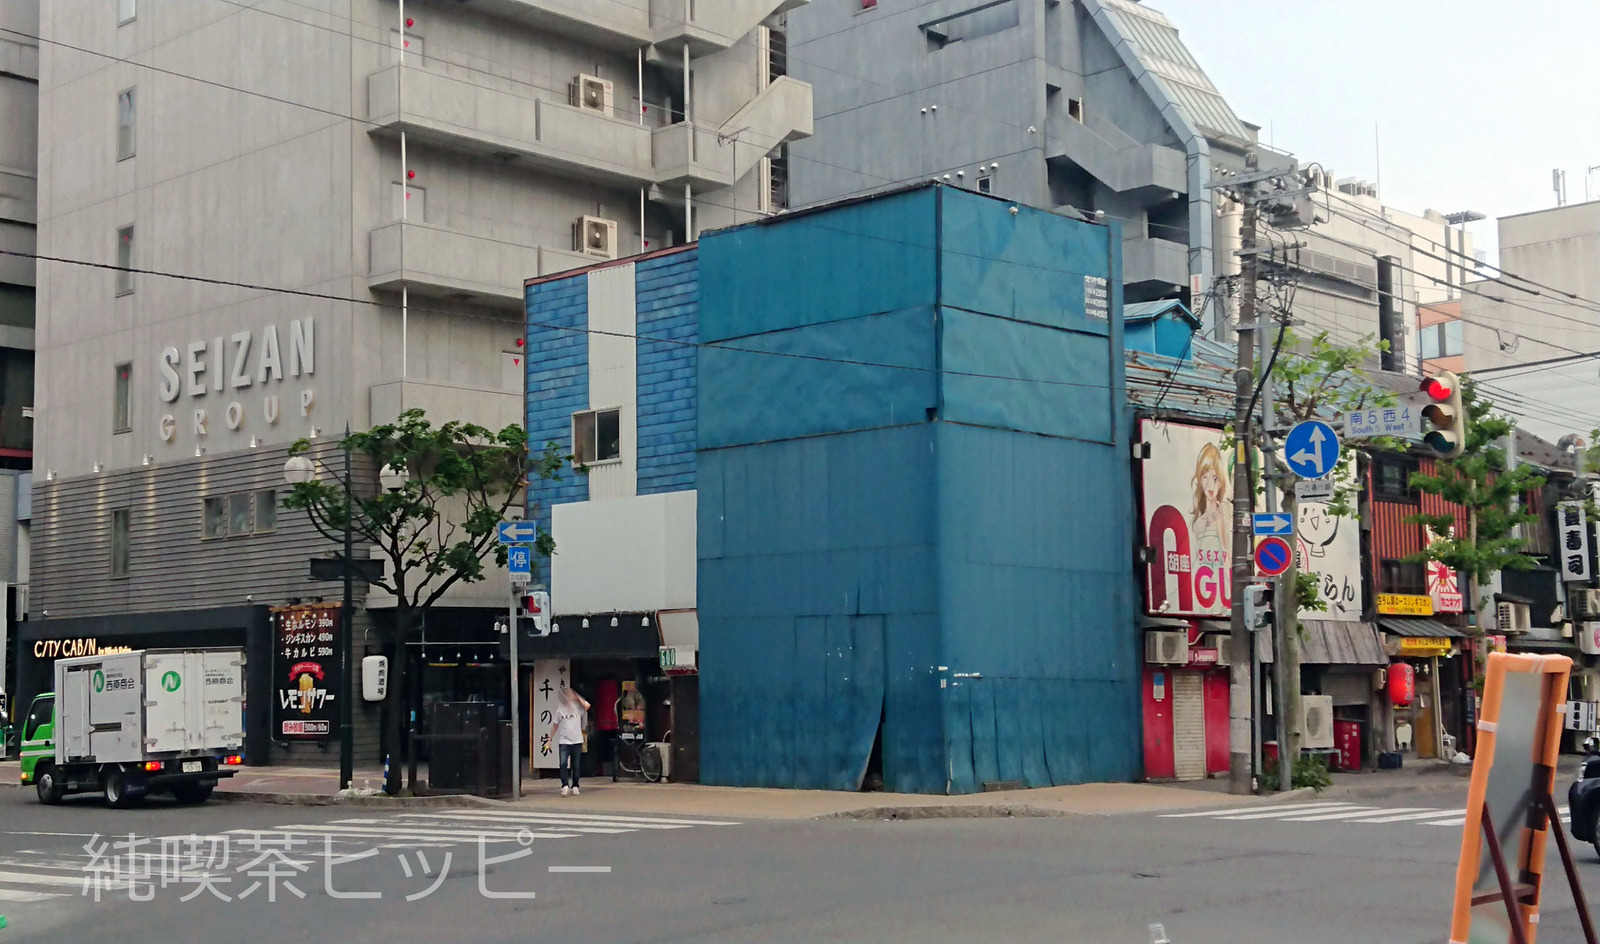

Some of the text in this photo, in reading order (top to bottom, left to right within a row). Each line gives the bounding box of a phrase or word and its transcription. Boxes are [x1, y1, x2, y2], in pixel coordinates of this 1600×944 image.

[159, 317, 315, 403] SEIZAN
[159, 389, 315, 442] GROUP
[1352, 425, 1374, 434] South
[1384, 422, 1405, 431] West
[510, 551, 527, 568] 停
[1168, 553, 1191, 573] 胡座
[1198, 549, 1228, 562] SEXY
[34, 640, 61, 657] CITY
[62, 638, 96, 656] CABIN
[285, 633, 316, 644] ジンギスカン
[280, 688, 335, 709] レモンサワー
[540, 679, 554, 757] 千の家
